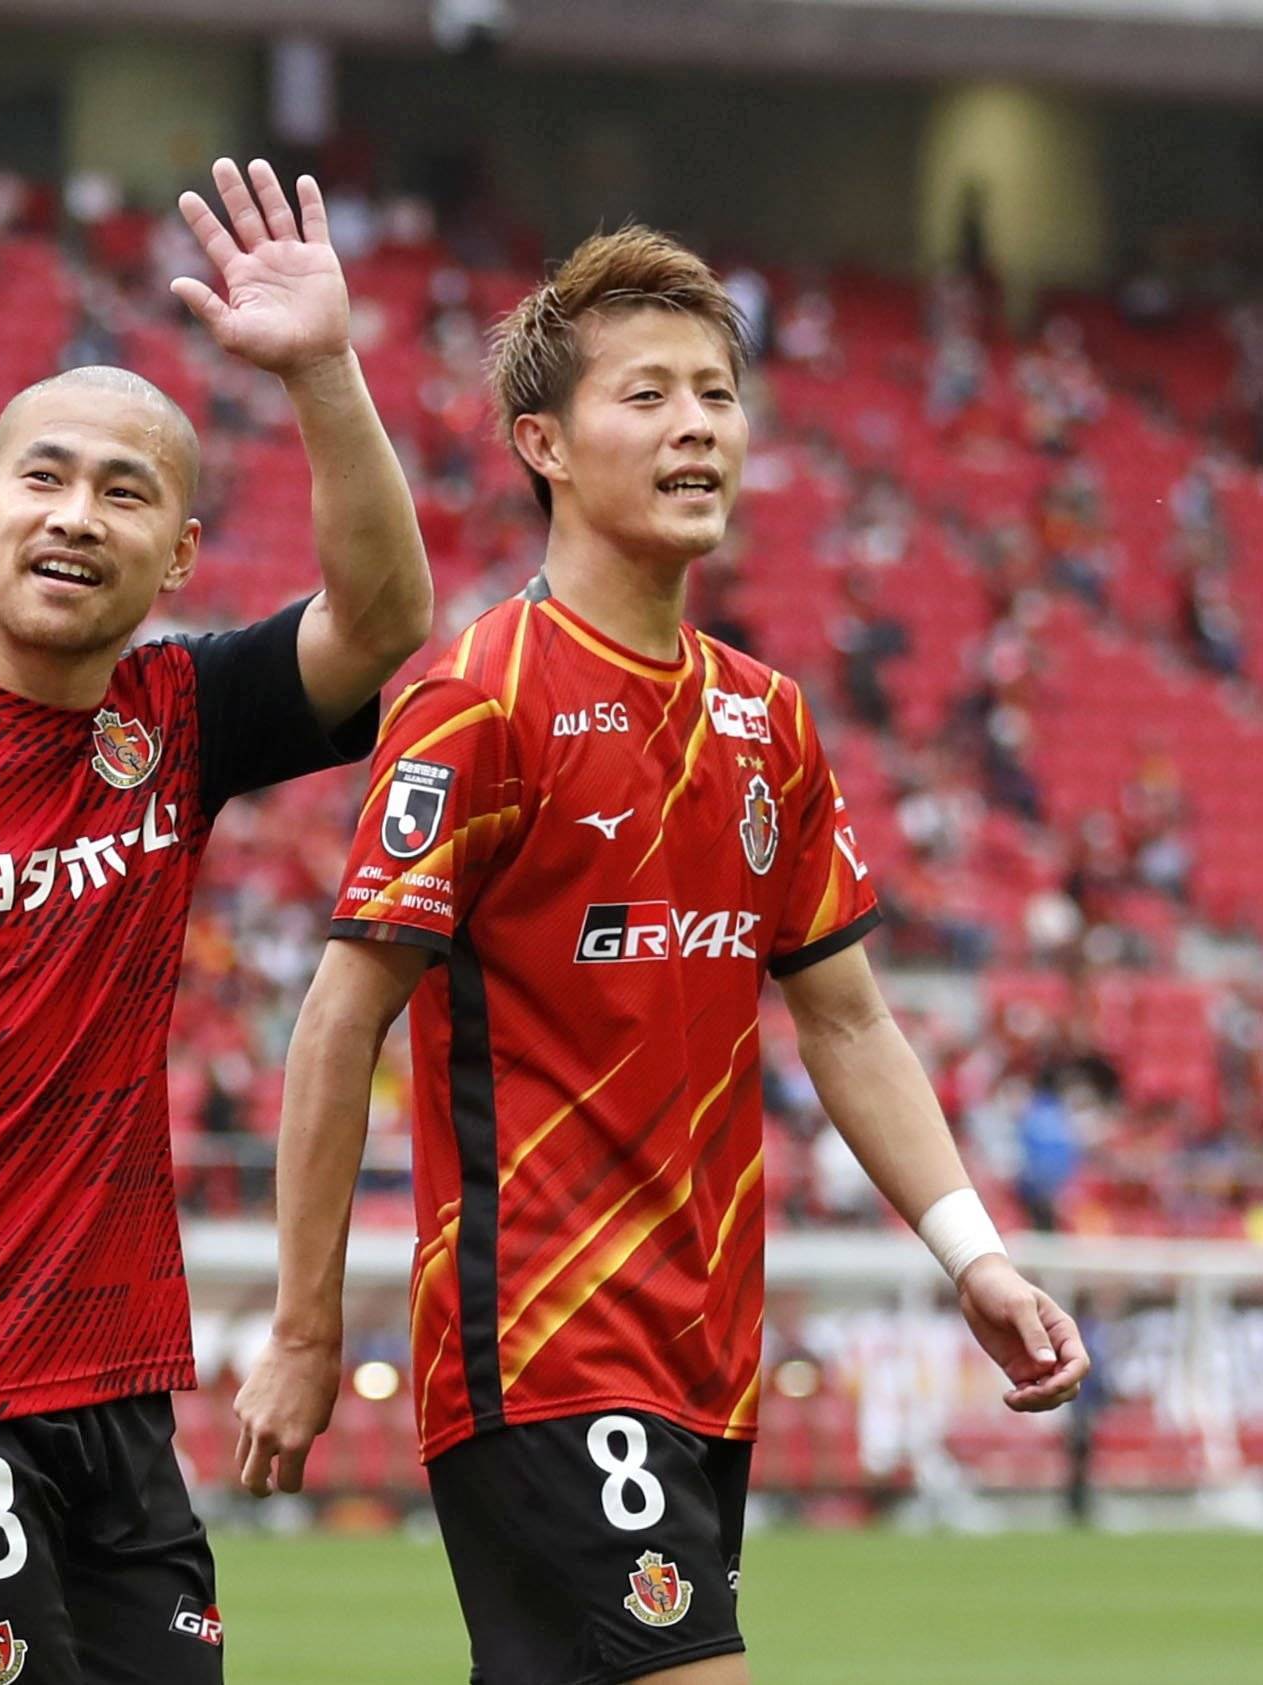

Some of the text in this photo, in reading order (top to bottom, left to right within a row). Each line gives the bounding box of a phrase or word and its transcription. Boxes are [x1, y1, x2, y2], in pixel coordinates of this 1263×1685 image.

[552, 702, 629, 737] au 5G
[400, 872, 451, 895] NAGOYA
[401, 894, 453, 918] MIYOSHI
[581, 925, 667, 959] GR
[587, 1415, 666, 1531] 8
[175, 1611, 223, 1642] GR
